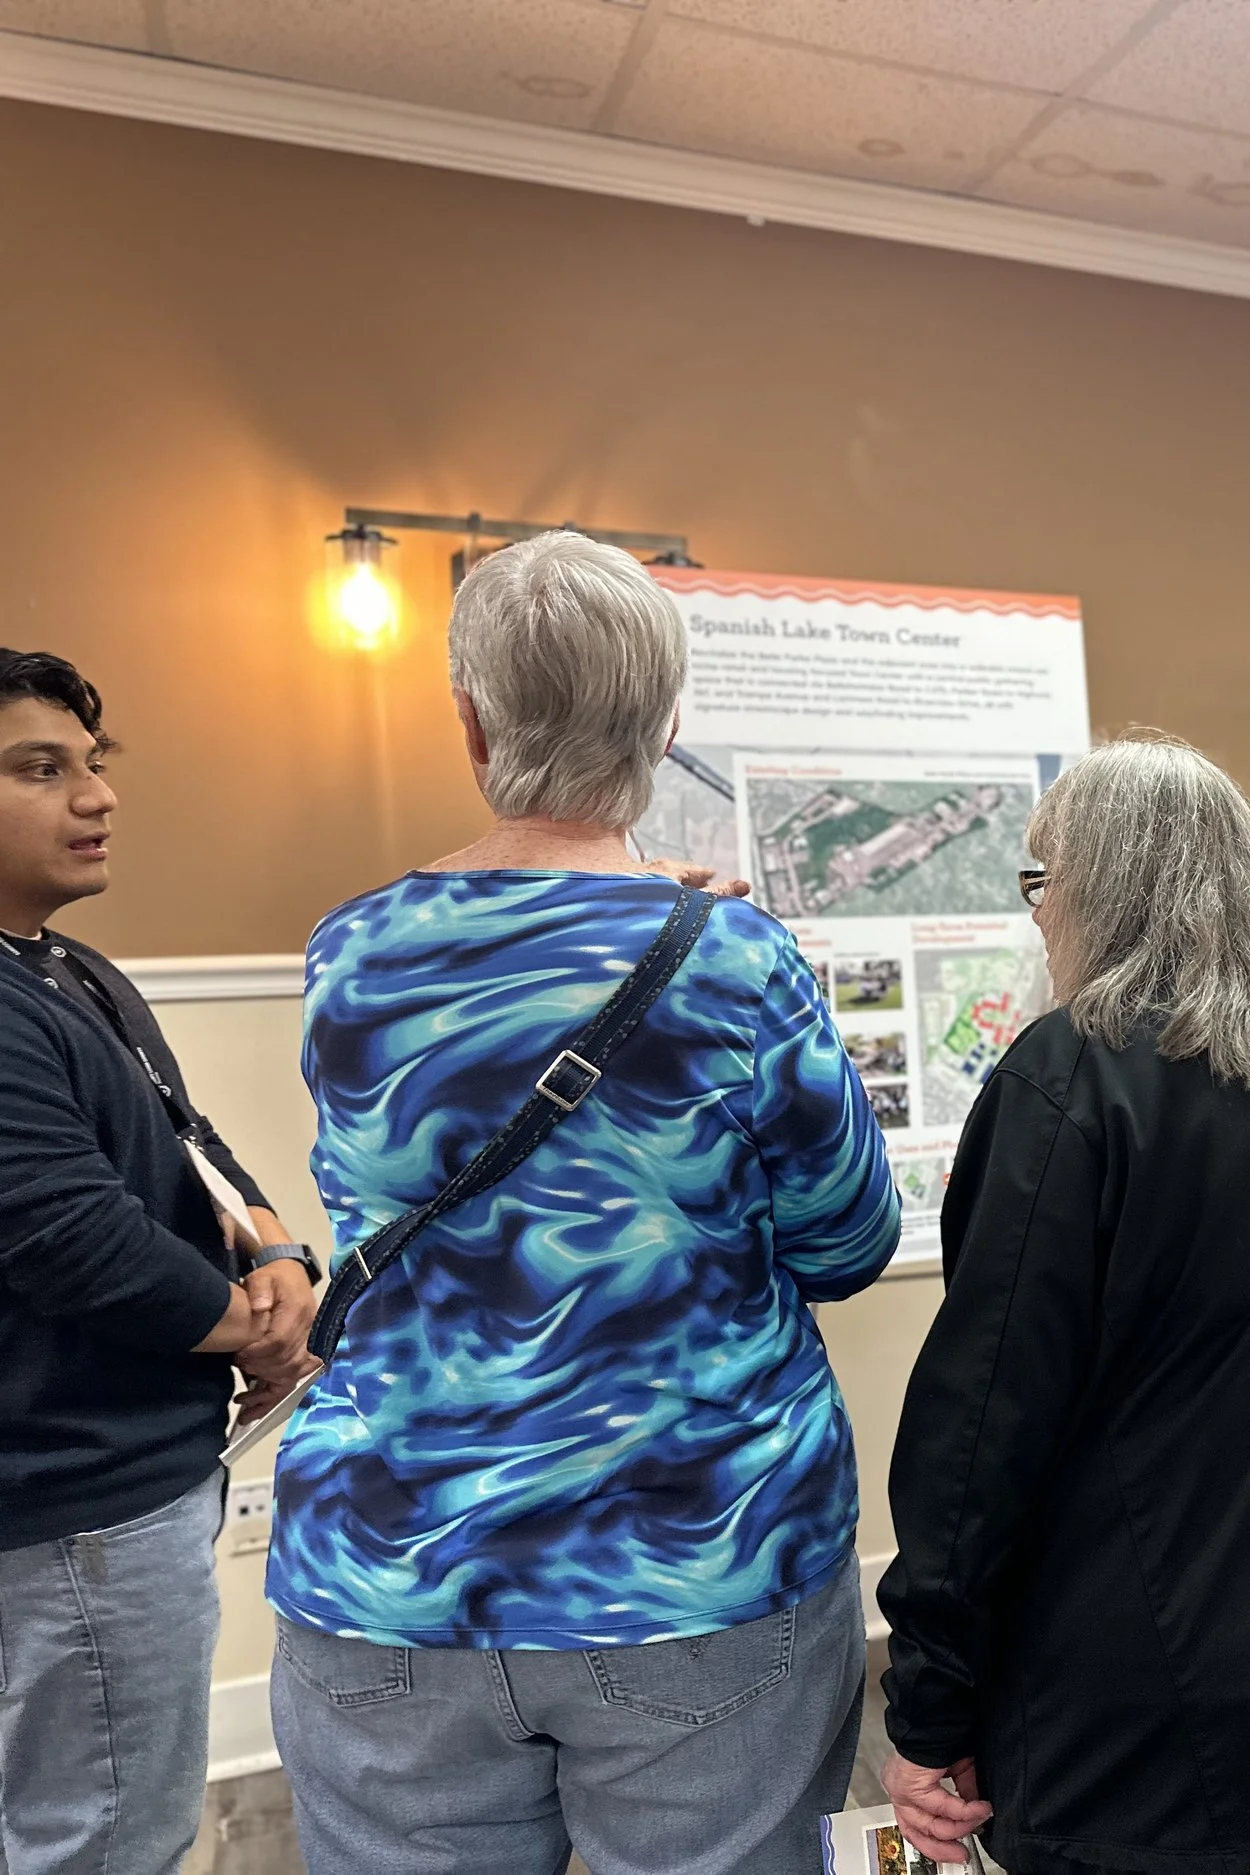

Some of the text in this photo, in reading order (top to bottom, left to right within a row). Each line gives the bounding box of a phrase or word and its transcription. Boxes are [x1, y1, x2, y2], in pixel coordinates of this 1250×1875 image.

[689, 614, 961, 648] Spanish Lake Town Center
